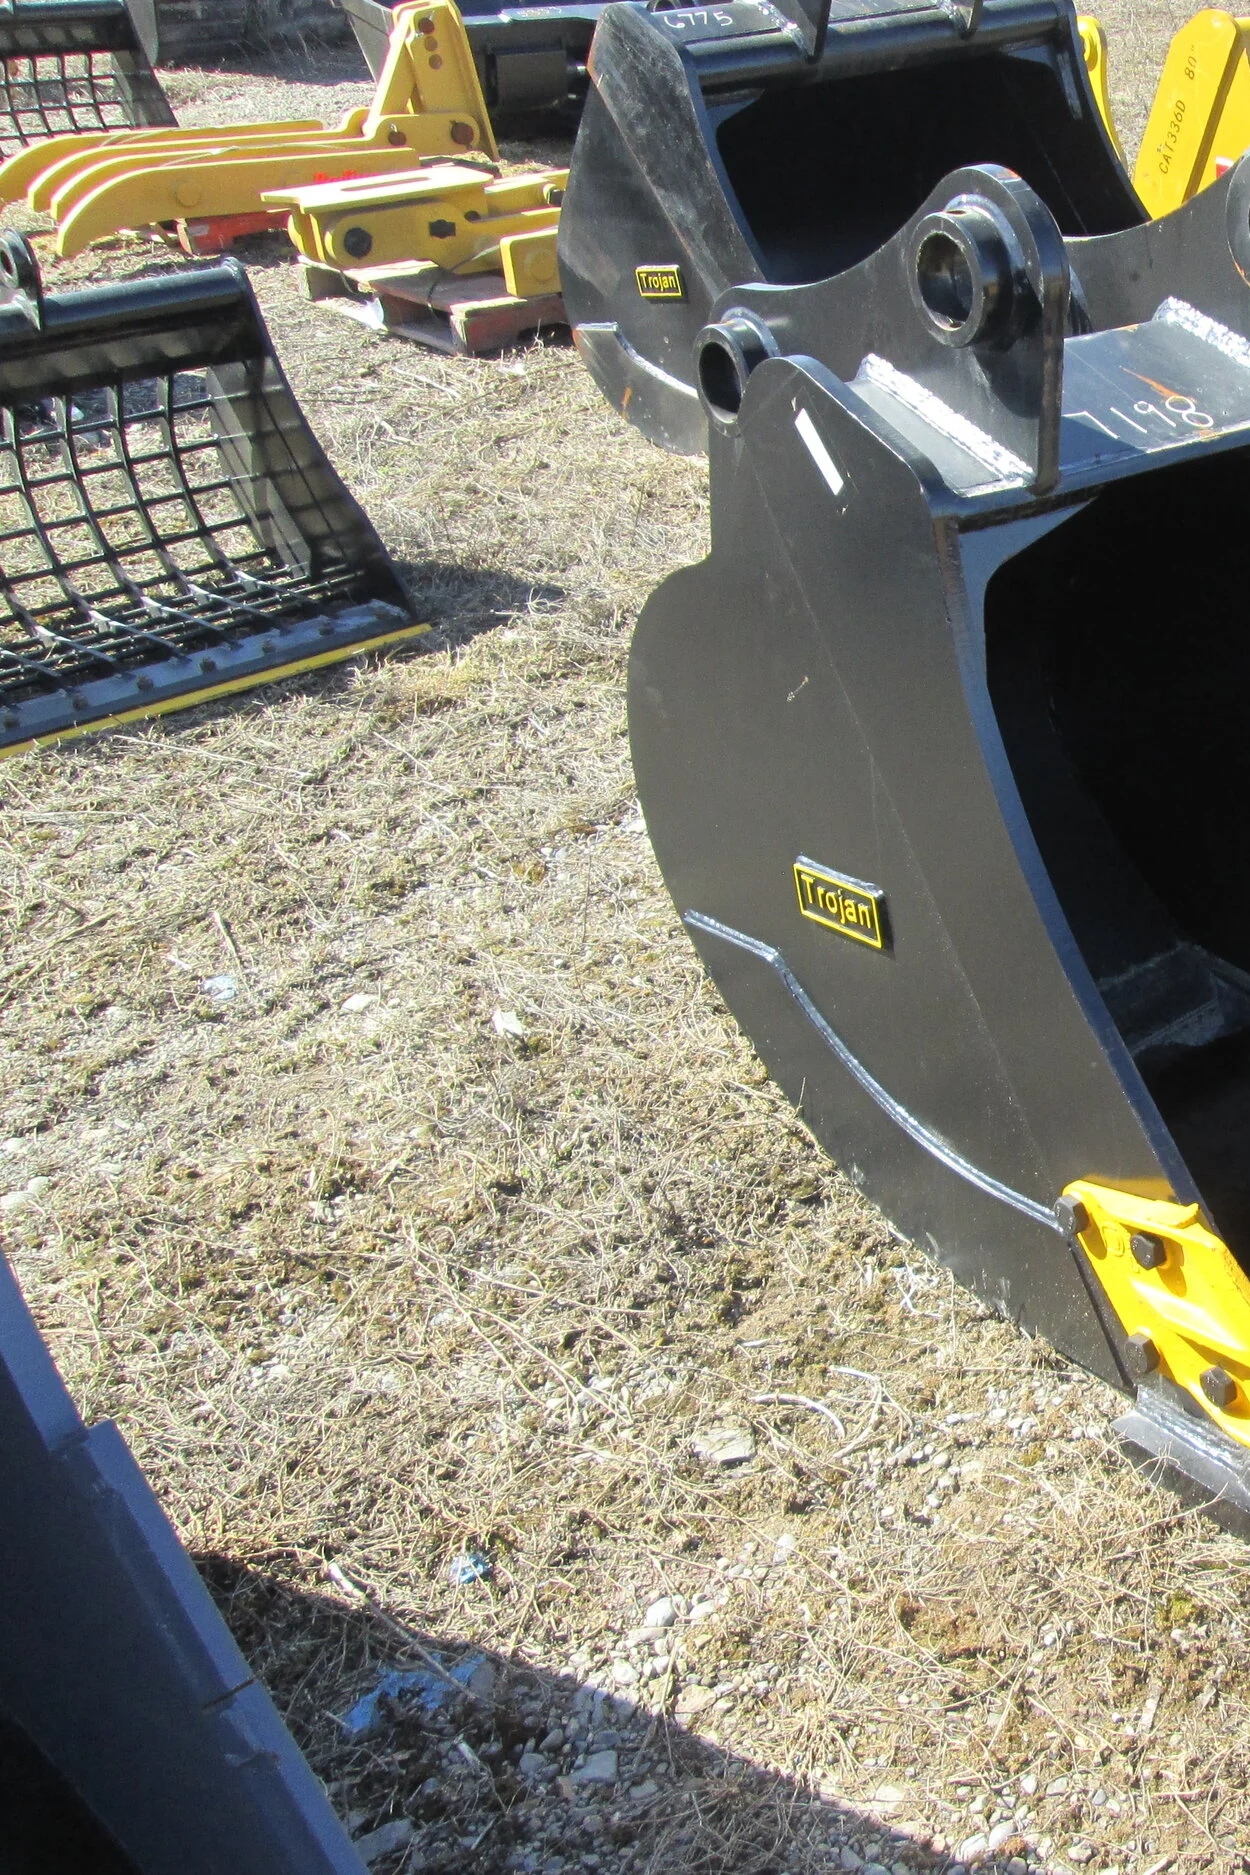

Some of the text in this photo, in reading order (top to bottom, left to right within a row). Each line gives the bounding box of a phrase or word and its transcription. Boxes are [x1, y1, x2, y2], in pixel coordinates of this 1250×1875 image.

[664, 11, 733, 29] 6775
[1158, 99, 1186, 175] CAT336D
[639, 272, 676, 292] Trojan
[1061, 395, 1214, 440] 7198
[800, 873, 871, 929] Trojan
